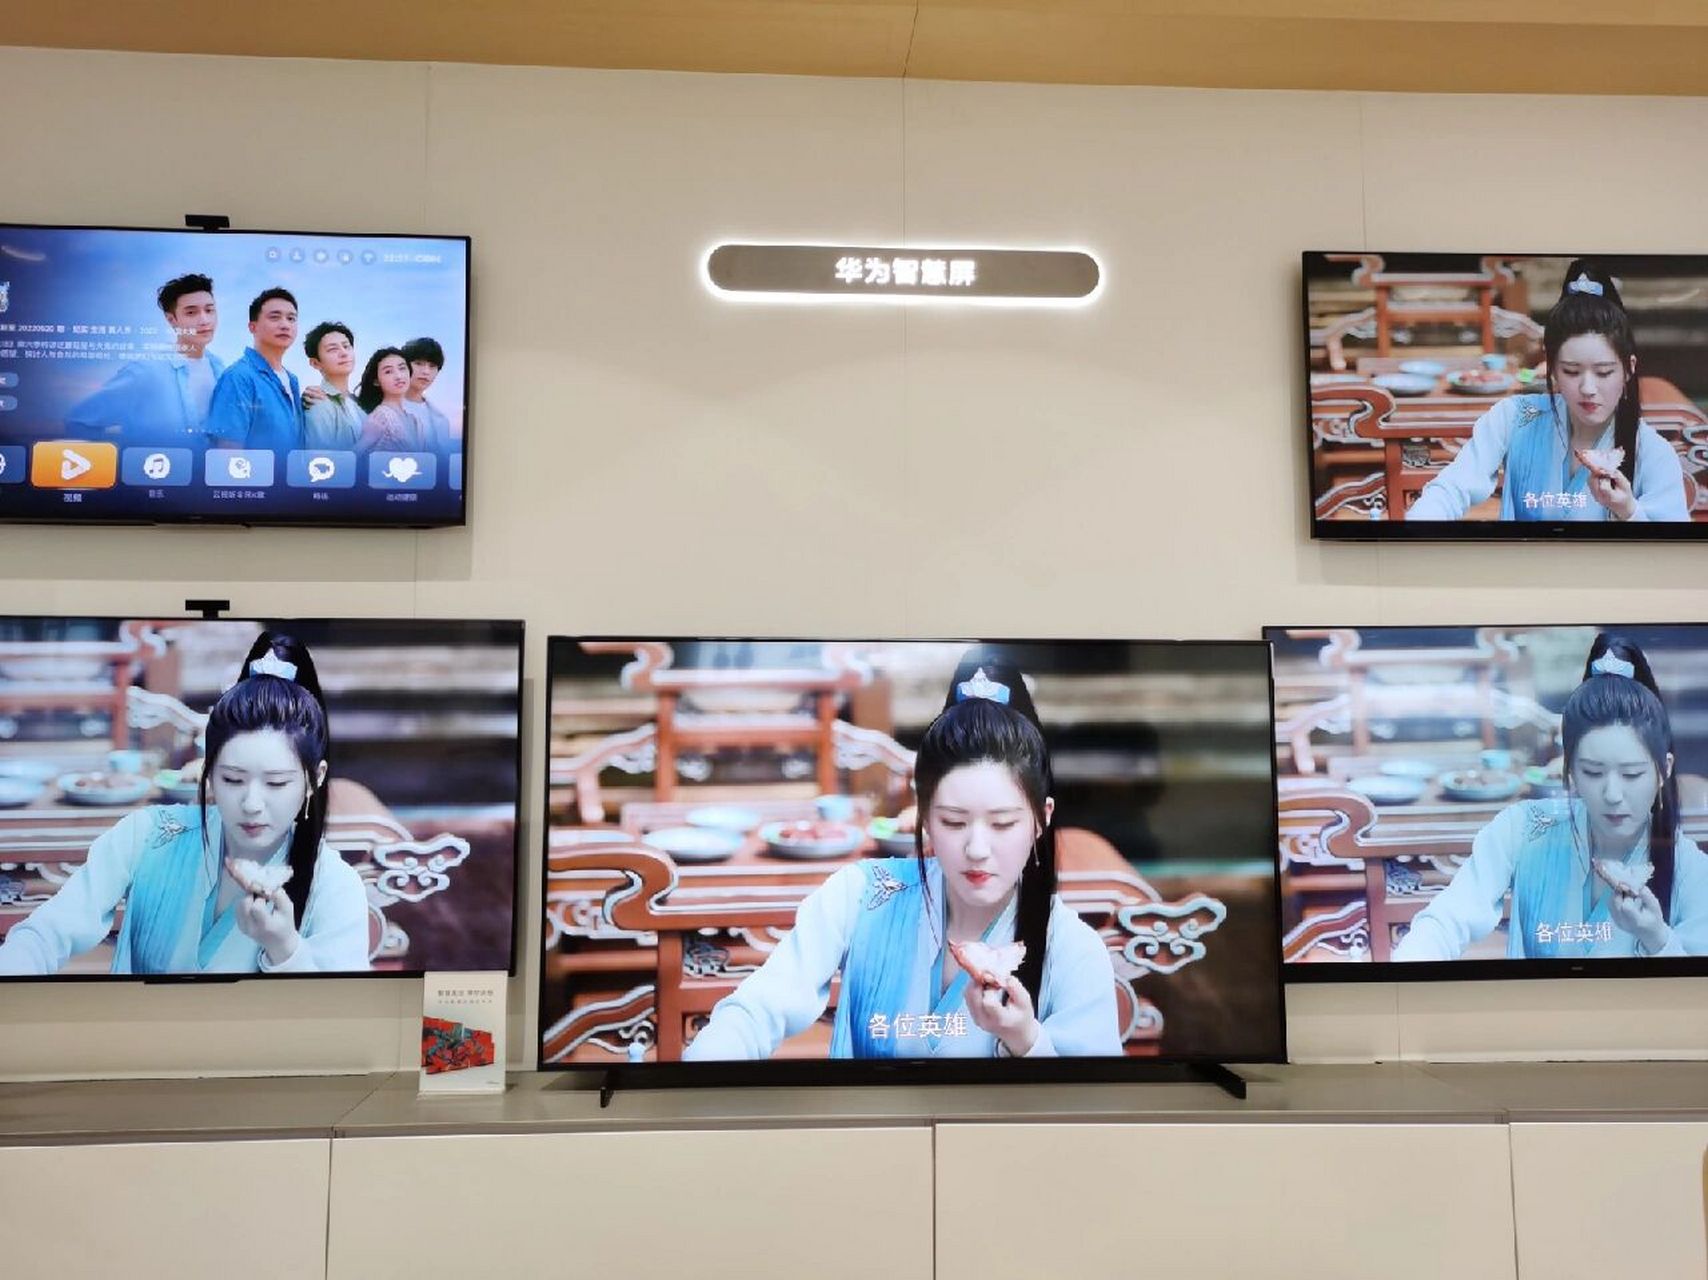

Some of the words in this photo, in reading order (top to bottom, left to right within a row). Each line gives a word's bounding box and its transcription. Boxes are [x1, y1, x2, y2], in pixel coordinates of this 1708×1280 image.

[834, 256, 976, 286] 华为智慧屏
[1524, 492, 1587, 508] 各位英雄
[1536, 922, 1611, 943] 各位英雄
[869, 1012, 967, 1039] 各位英雄
